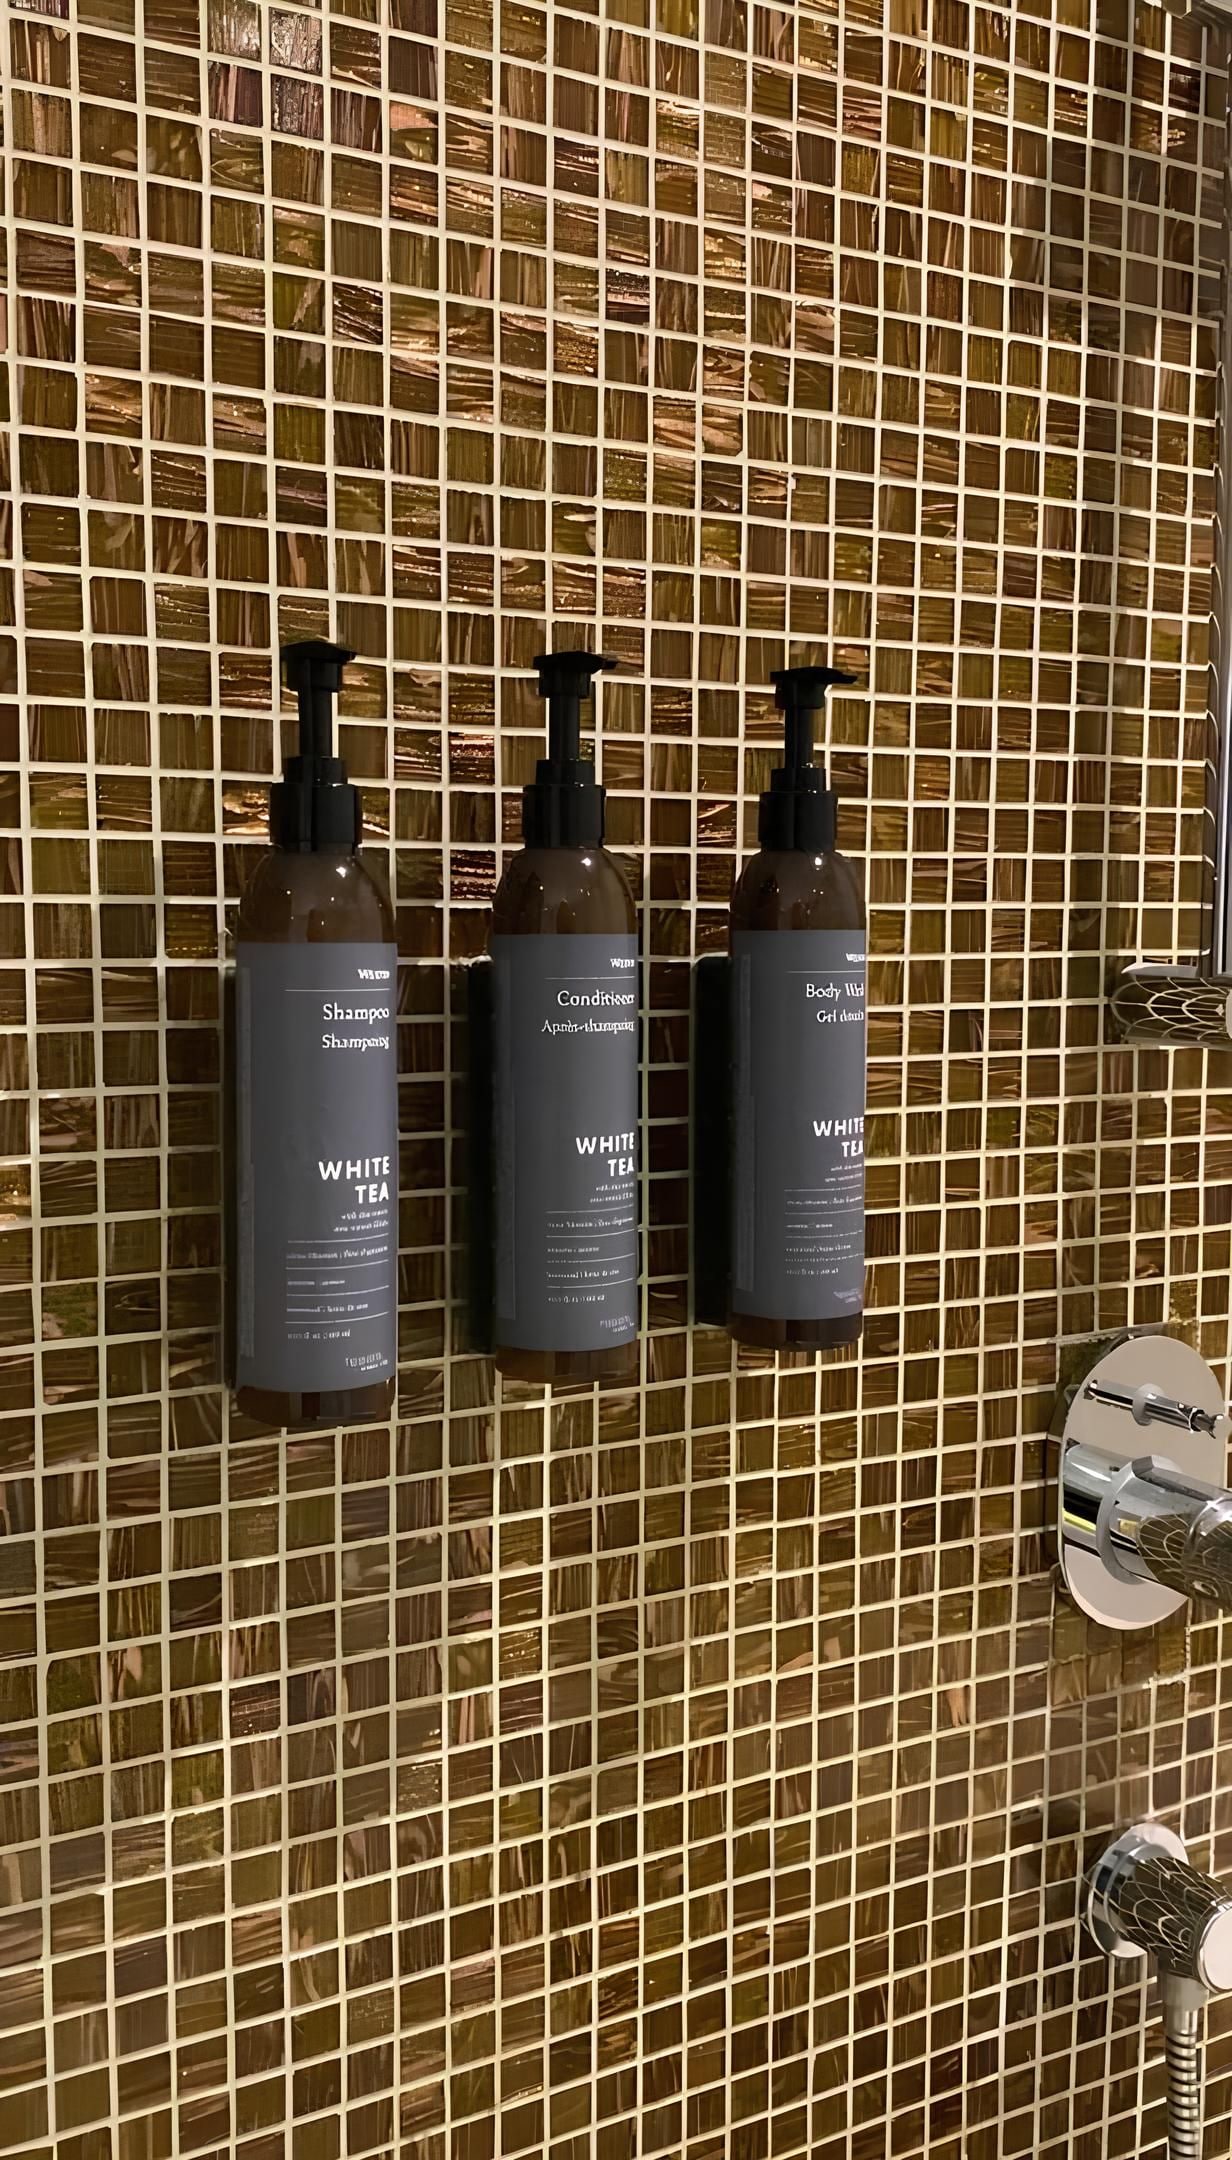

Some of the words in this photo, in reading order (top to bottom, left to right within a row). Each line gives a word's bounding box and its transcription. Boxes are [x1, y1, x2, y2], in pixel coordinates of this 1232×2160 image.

[806, 982, 841, 1002] Body
[323, 1002, 390, 1025] Shampoo
[813, 1116, 864, 1137] WHITE
[575, 1132, 635, 1155] WHITE
[841, 1140, 864, 1158] TEA
[318, 1155, 390, 1180] WHITE
[608, 1156, 635, 1177] TEA
[354, 1181, 389, 1204] TEA
